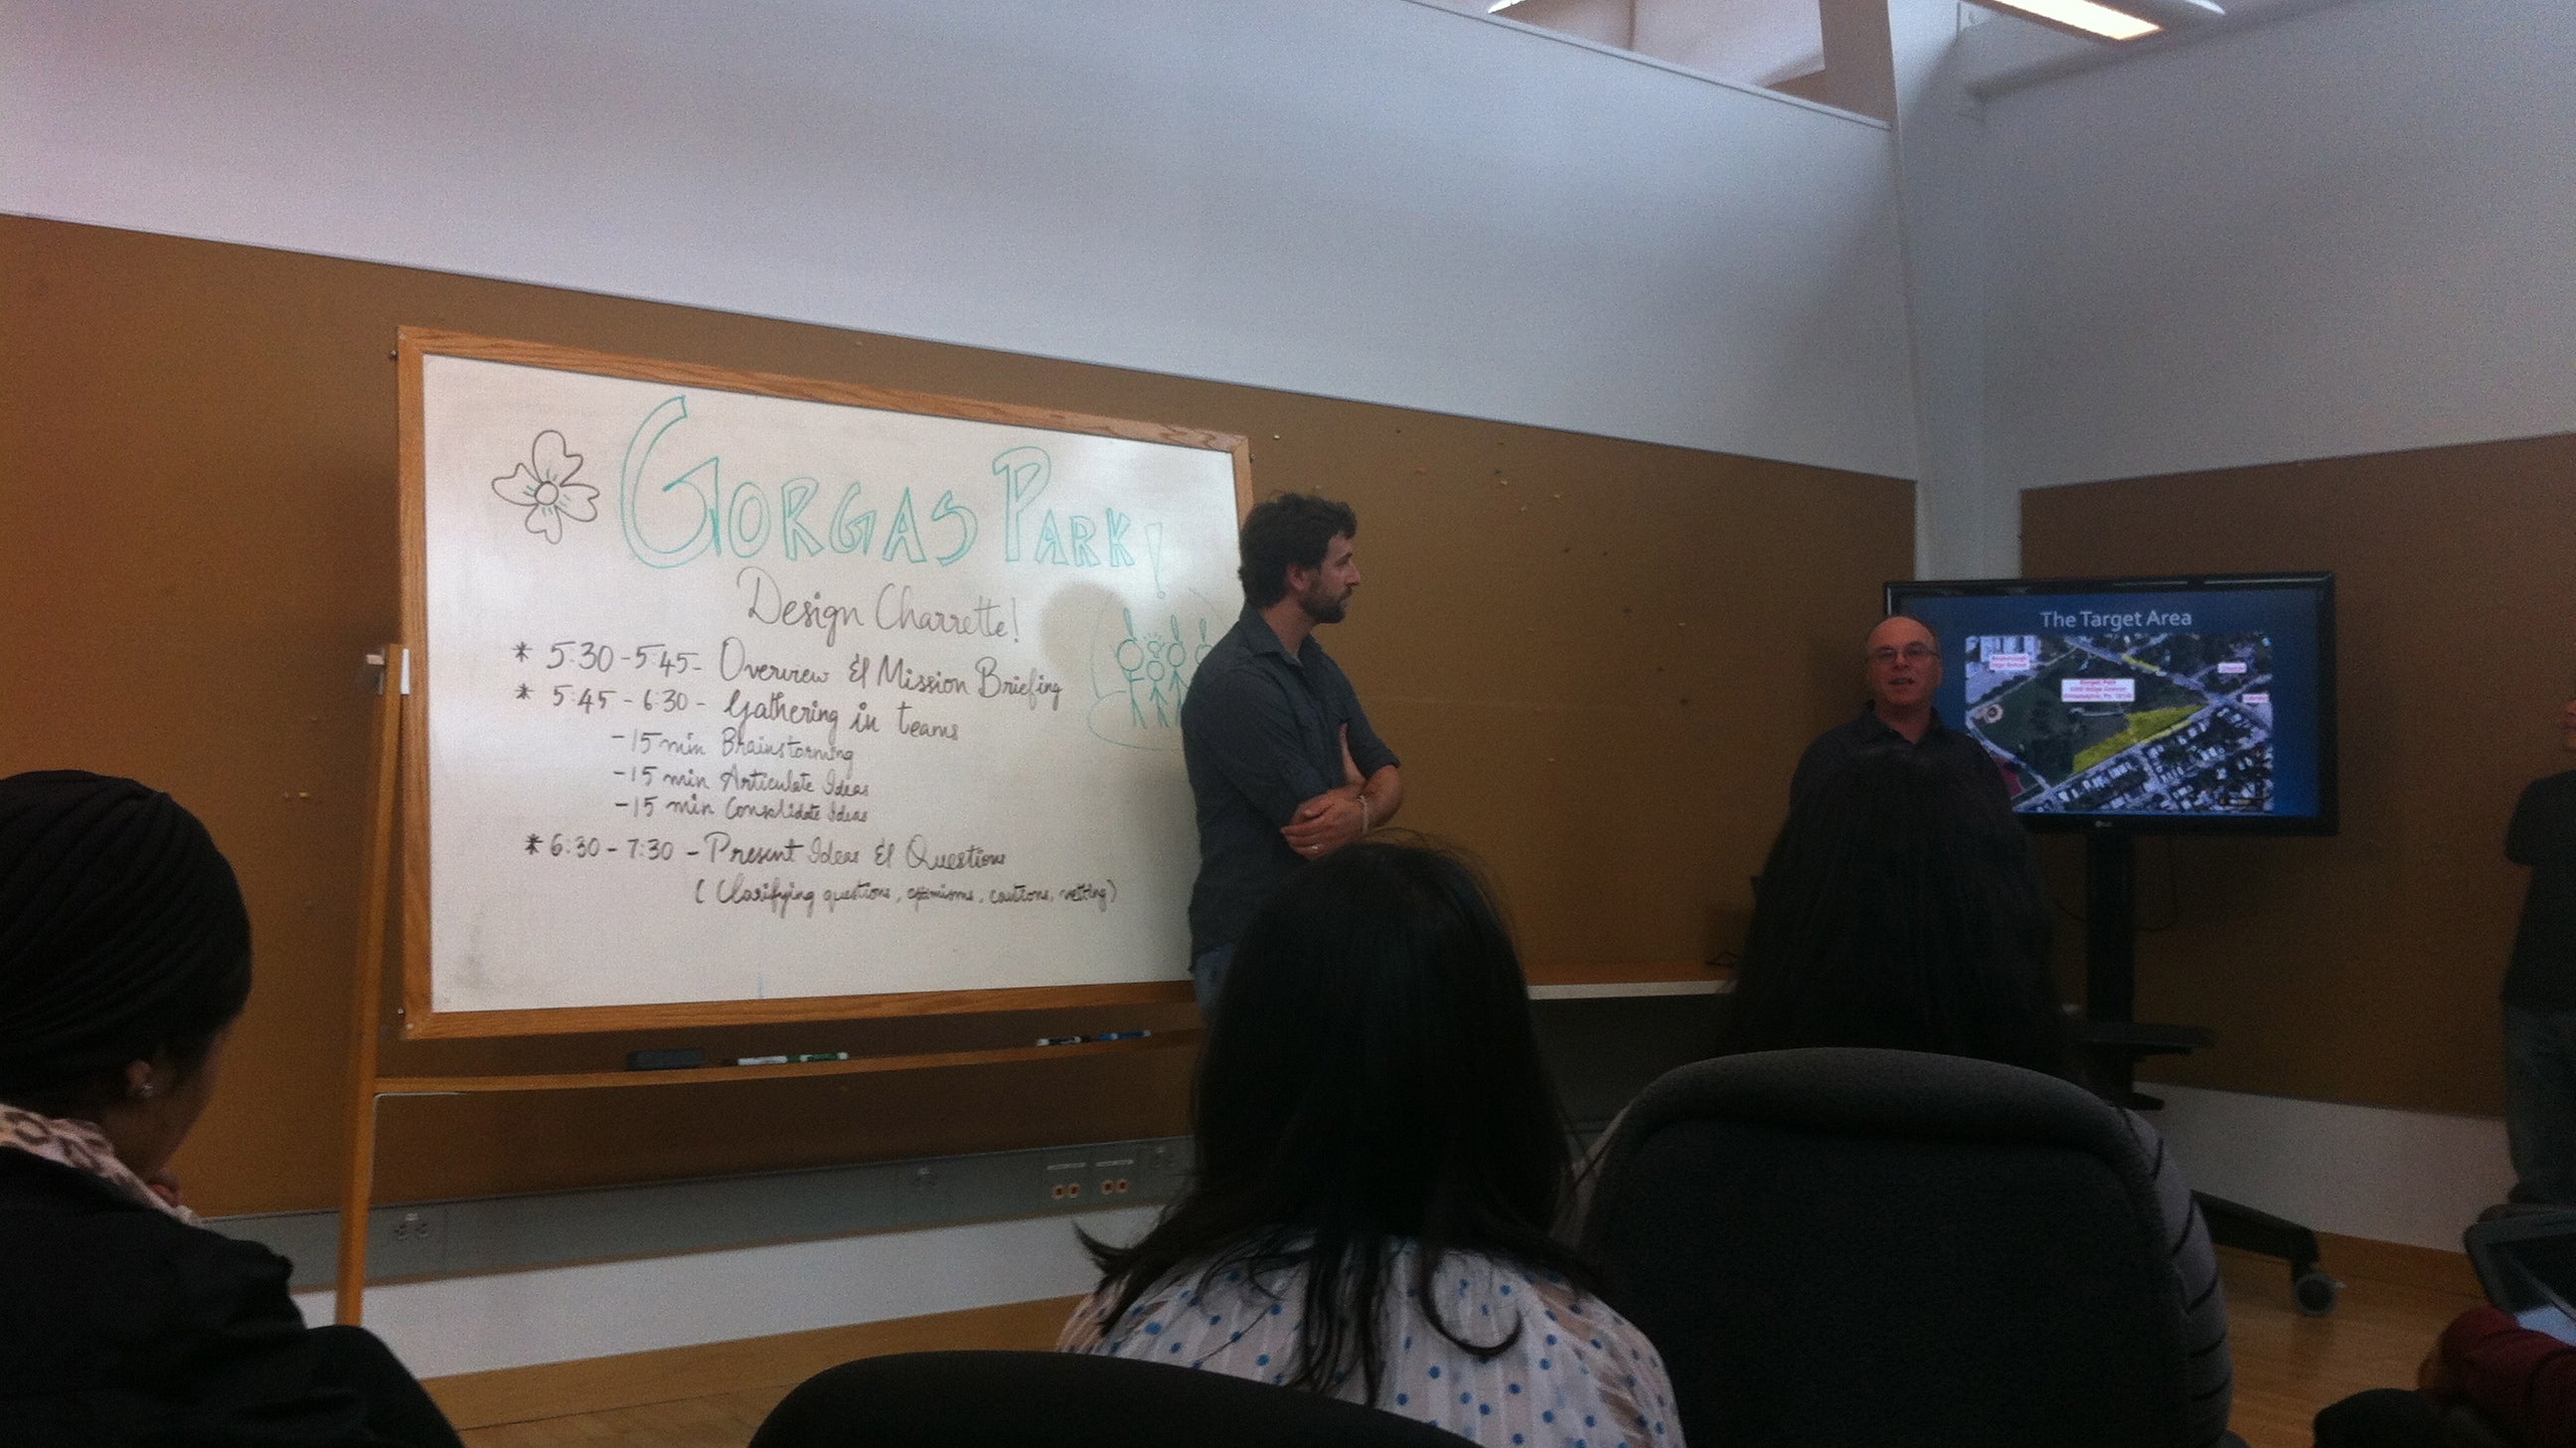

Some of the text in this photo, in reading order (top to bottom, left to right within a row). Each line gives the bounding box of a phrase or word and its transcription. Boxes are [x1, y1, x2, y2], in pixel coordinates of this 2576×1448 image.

[736, 565, 1020, 647] Design Charrette!
[2040, 609, 2192, 632] The Target Area
[720, 636, 830, 682] Overview
[877, 654, 971, 697] Mission
[975, 656, 1063, 711] Briefing
[724, 689, 841, 746] Gathering
[849, 702, 881, 733] in
[896, 701, 960, 741] teams
[663, 731, 707, 756] min
[721, 726, 855, 781] Brainstorming
[662, 769, 710, 789] min
[720, 764, 815, 793] Articulate
[823, 768, 870, 797] Ideas
[665, 793, 716, 816] min
[724, 795, 821, 821] Consolidate
[827, 799, 869, 823] Ideas
[704, 831, 804, 865] Present
[808, 837, 861, 866] Ideas
[905, 834, 1006, 871] Questions
